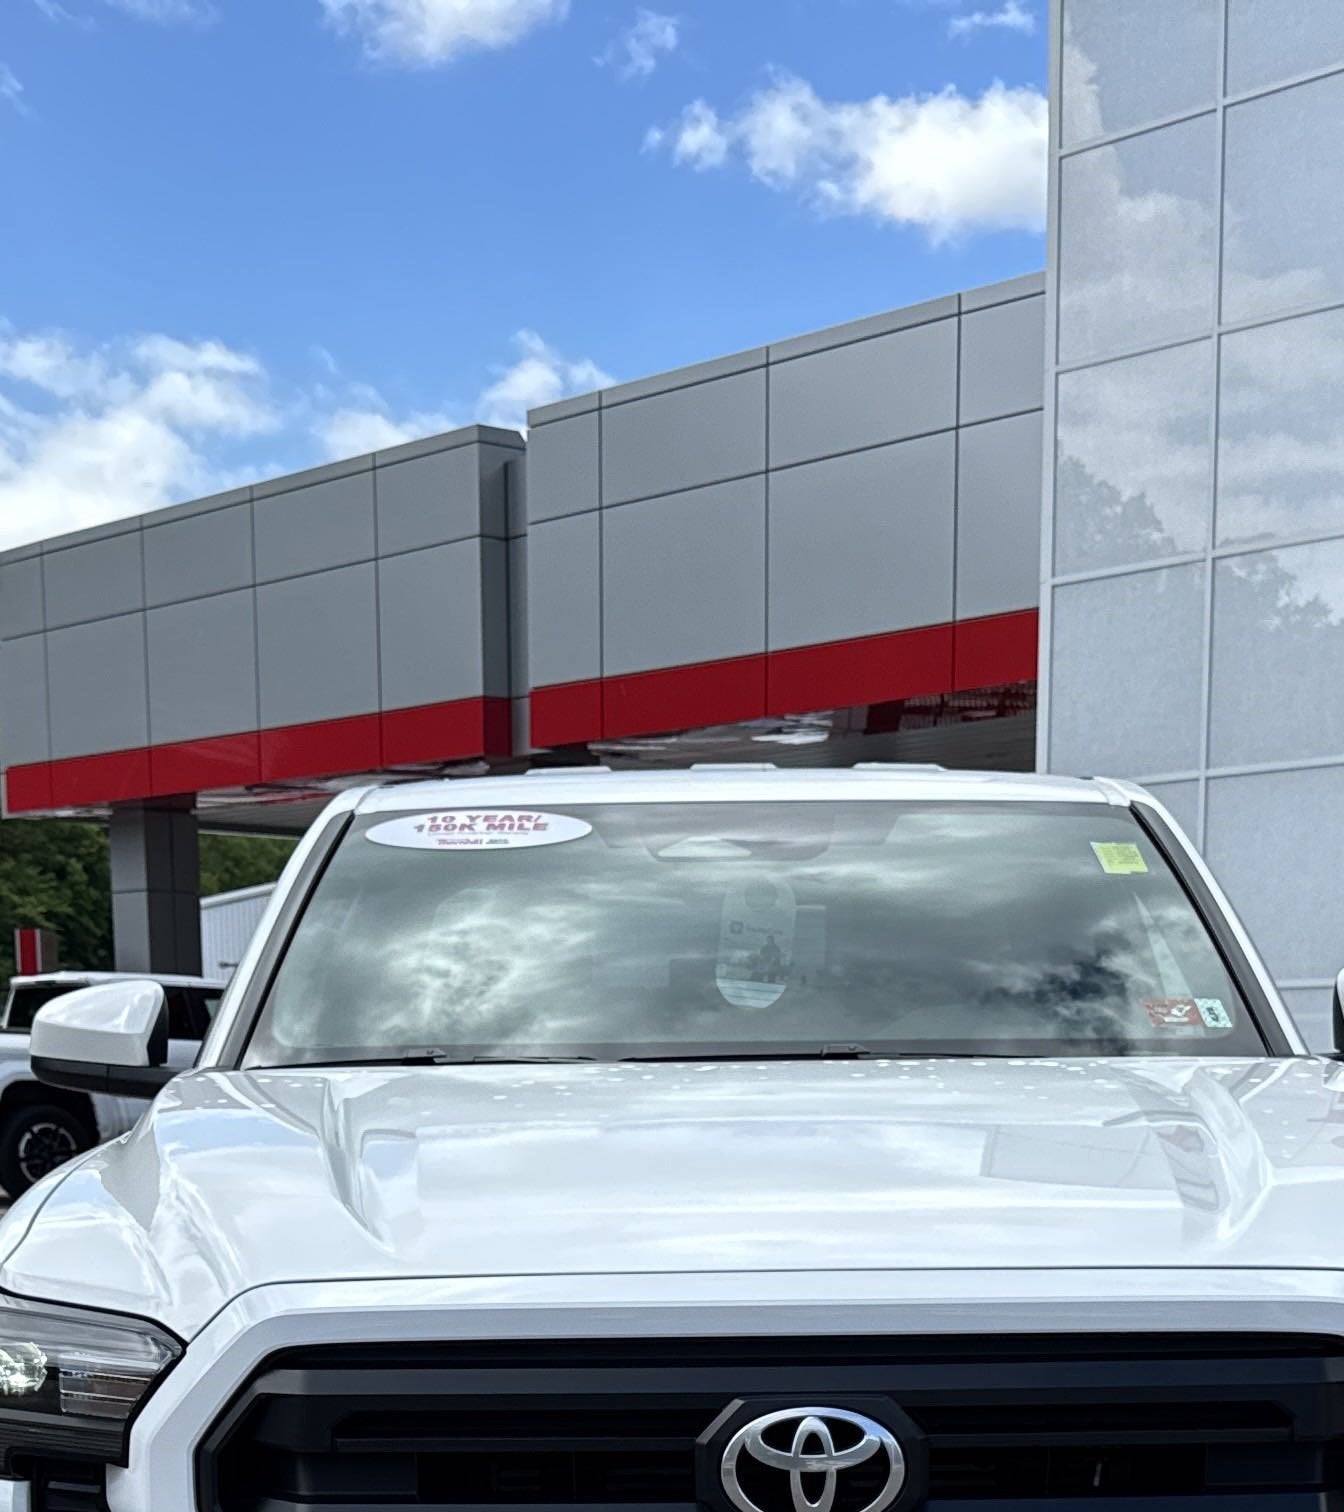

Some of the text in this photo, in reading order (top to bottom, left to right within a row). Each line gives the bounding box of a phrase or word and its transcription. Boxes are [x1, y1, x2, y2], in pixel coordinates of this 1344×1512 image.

[427, 814, 543, 824] 10 YEAR/
[486, 822, 549, 832] MILE
